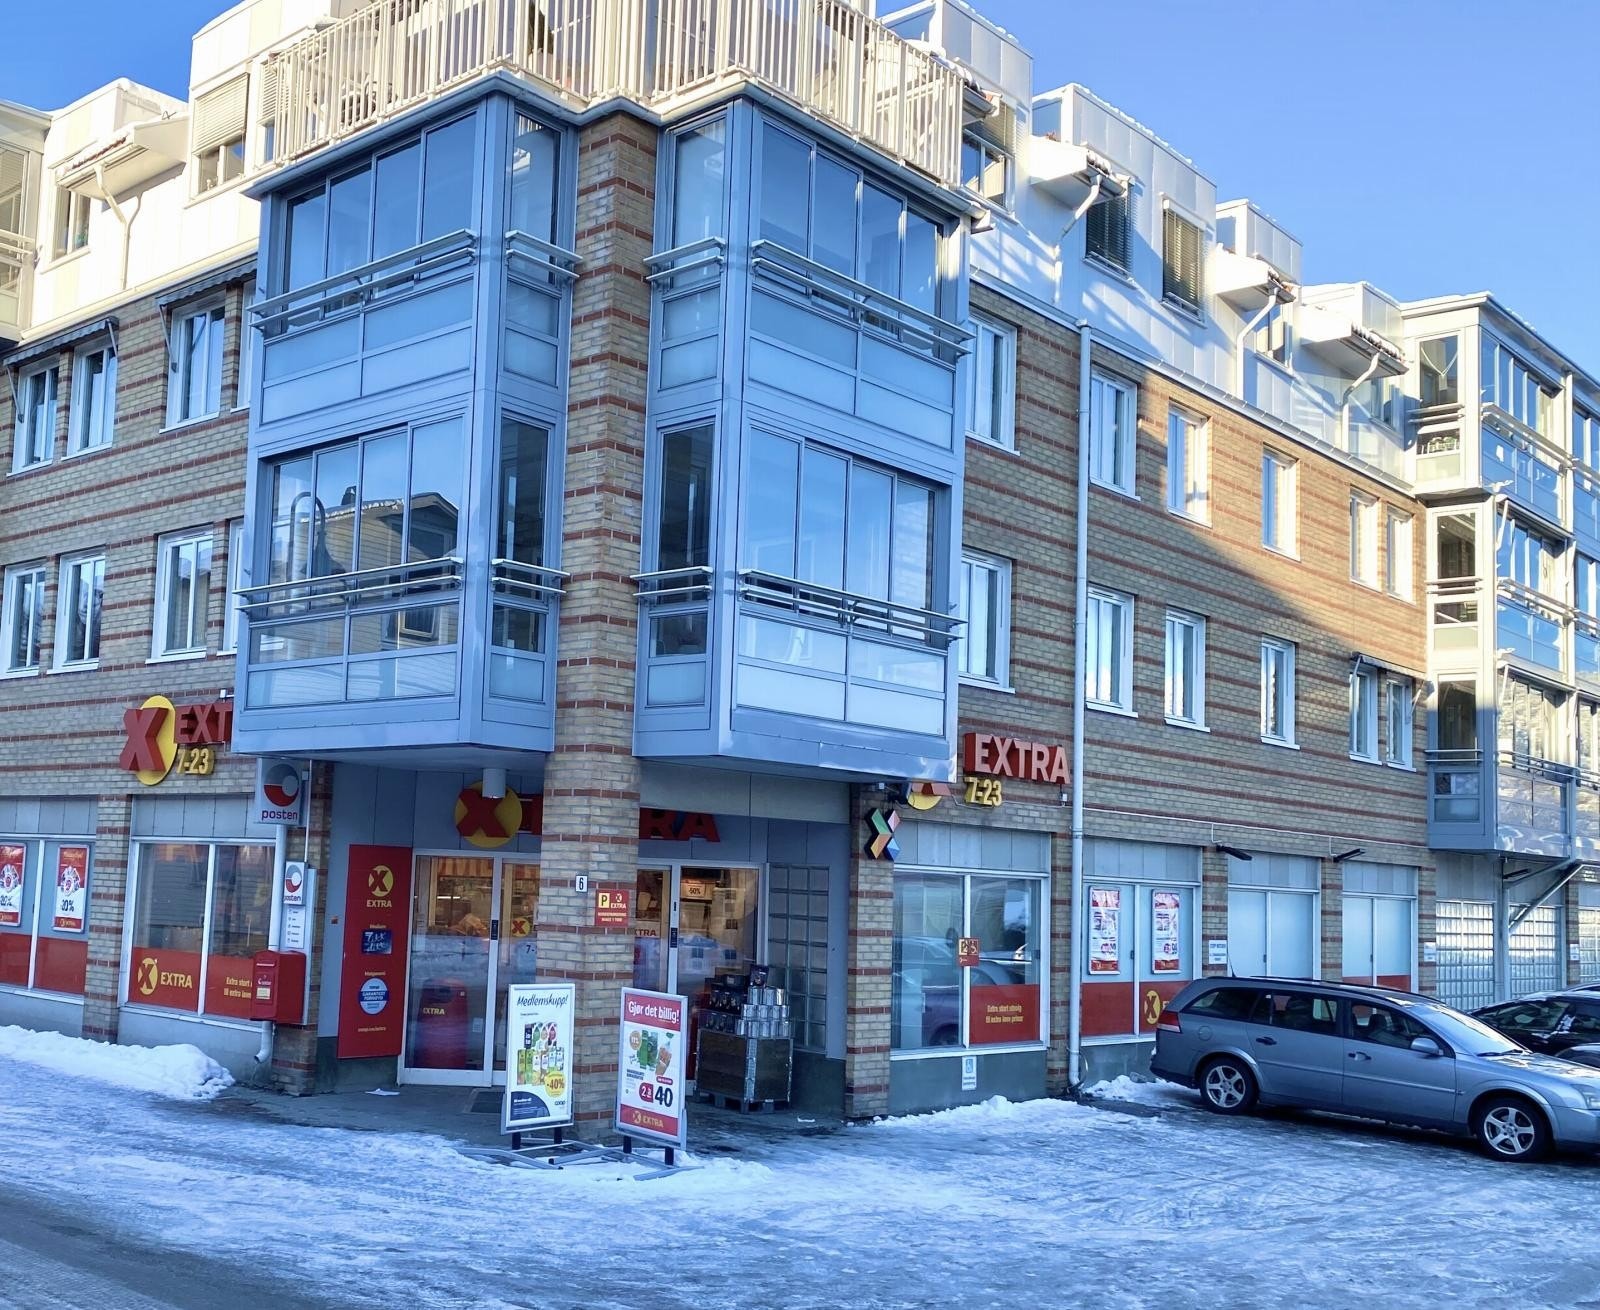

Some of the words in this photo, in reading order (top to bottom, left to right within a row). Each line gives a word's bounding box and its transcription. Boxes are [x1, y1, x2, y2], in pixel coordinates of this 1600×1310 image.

[177, 748, 212, 775] 7-23
[968, 733, 1071, 784] EXTRA
[965, 777, 1002, 807] 7-23
[262, 809, 298, 821] posten
[366, 899, 393, 908] EXTRA
[601, 894, 608, 906] P
[160, 972, 193, 989] EXTRA
[226, 976, 238, 986] Extra
[517, 994, 569, 1008] Medlemskupp!
[628, 1001, 643, 1016] Gjør
[645, 1004, 657, 1018] det
[658, 1006, 680, 1024] billig!
[655, 1086, 673, 1107] 40
[643, 1114, 664, 1129] EXTRA
